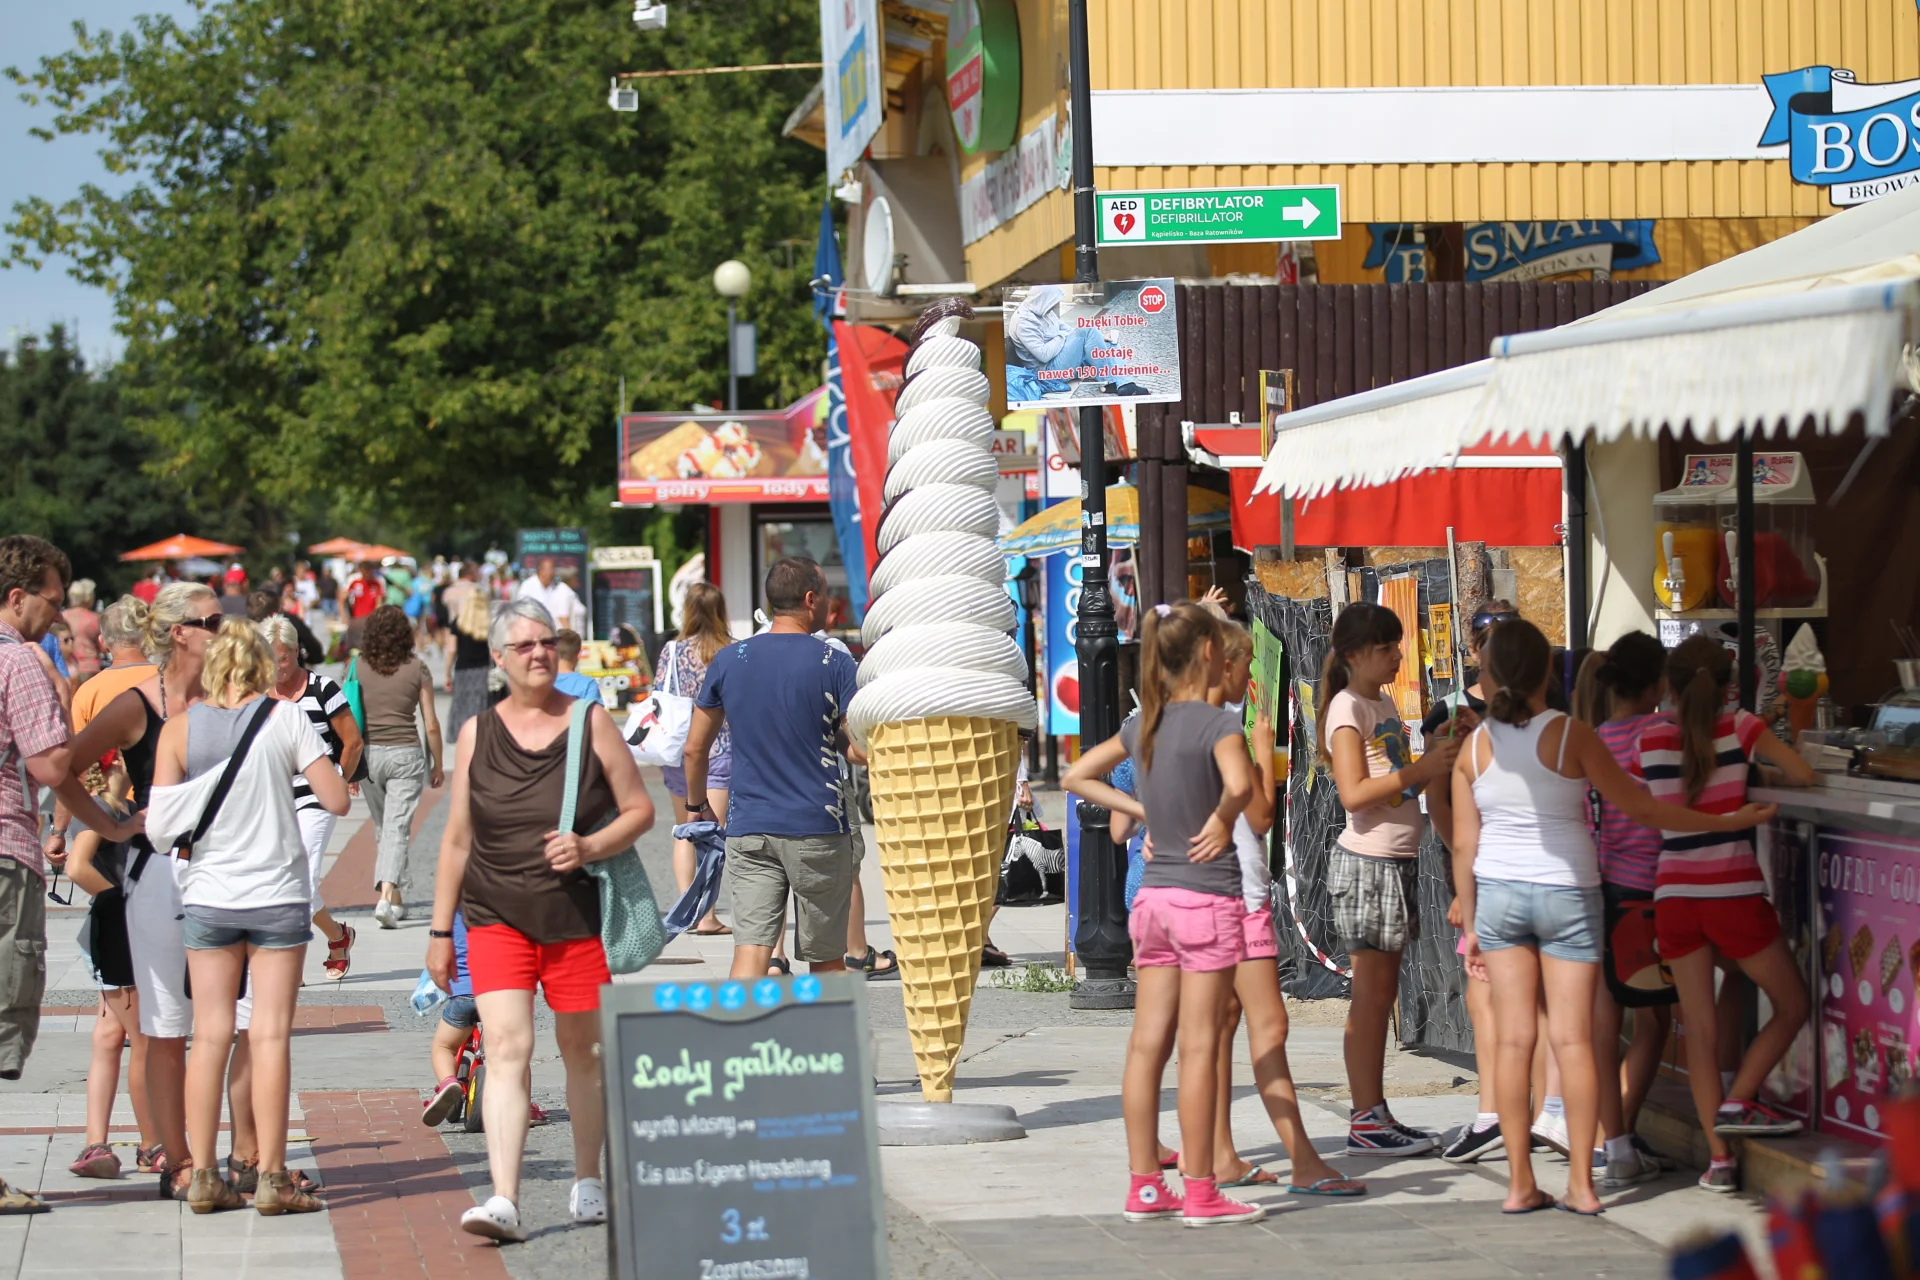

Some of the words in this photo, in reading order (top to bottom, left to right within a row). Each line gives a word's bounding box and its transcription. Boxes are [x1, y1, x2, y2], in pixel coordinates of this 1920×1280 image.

[1110, 200, 1138, 211] AED
[1150, 195, 1264, 211] DEFIBRYLATOR
[1151, 211, 1244, 224] DEFIBRILLATOR
[1205, 228, 1244, 236] Ratowników
[1142, 294, 1163, 306] STOP
[1077, 315, 1112, 330] Dzięki
[1114, 314, 1148, 328] Tobie,
[1091, 346, 1133, 360] dostaję
[1038, 368, 1074, 380] nawet
[1077, 367, 1097, 378] 150
[1099, 365, 1109, 377] zł
[990, 437, 1017, 453] AR
[1818, 852, 1877, 896] GOFRY
[1890, 864, 1920, 904] GO
[720, 1207, 742, 1244] 3
